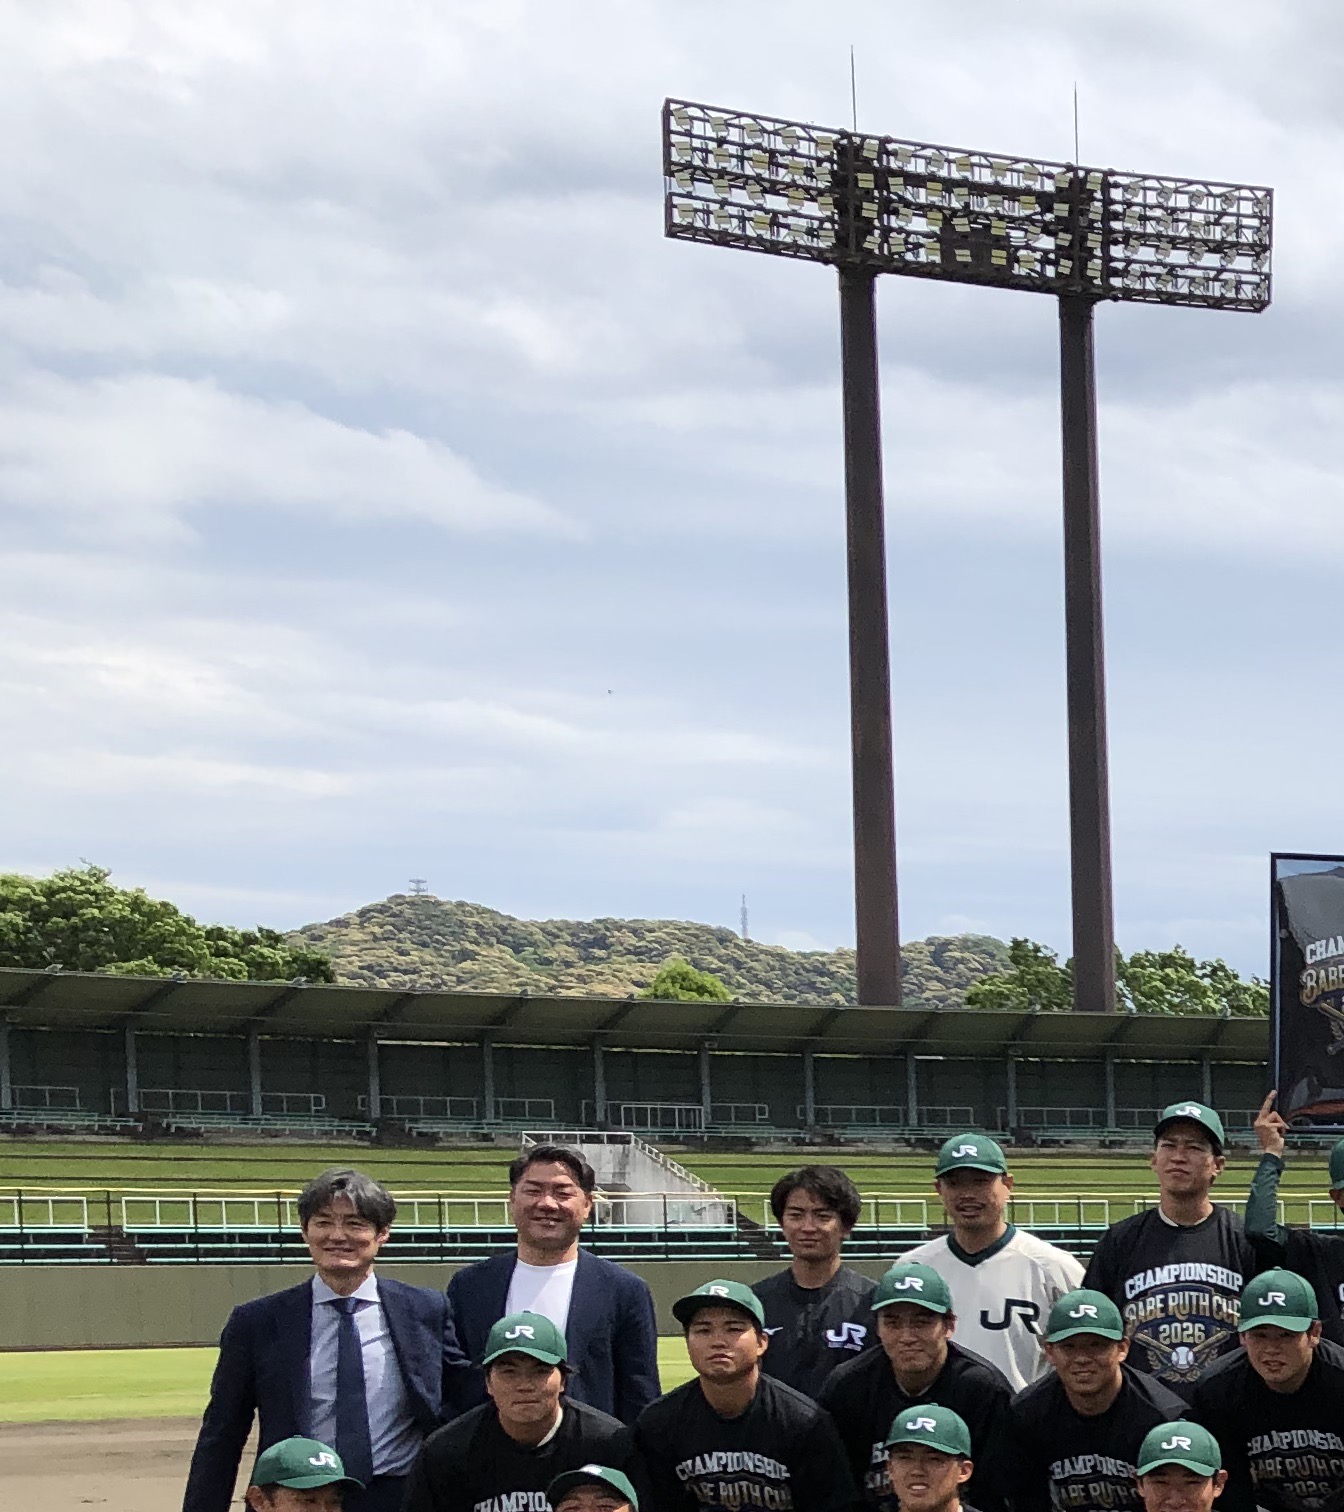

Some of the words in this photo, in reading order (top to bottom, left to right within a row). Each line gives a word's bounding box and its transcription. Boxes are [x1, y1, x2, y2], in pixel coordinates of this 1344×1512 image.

[1175, 1105, 1201, 1118] JR
[952, 1144, 978, 1158] JR
[894, 1276, 924, 1292] JR
[1124, 1262, 1243, 1299] CHAMPIONSHIP
[1168, 1291, 1210, 1321] RUTH
[1258, 1292, 1287, 1307] JR
[980, 1298, 1043, 1335] JR
[1069, 1304, 1098, 1319] JR
[504, 1324, 535, 1340] JR
[826, 1322, 867, 1346] JR
[1158, 1321, 1206, 1345] 2026
[906, 1417, 937, 1432] JR
[1161, 1435, 1191, 1450] JR
[308, 1451, 338, 1469] JR
